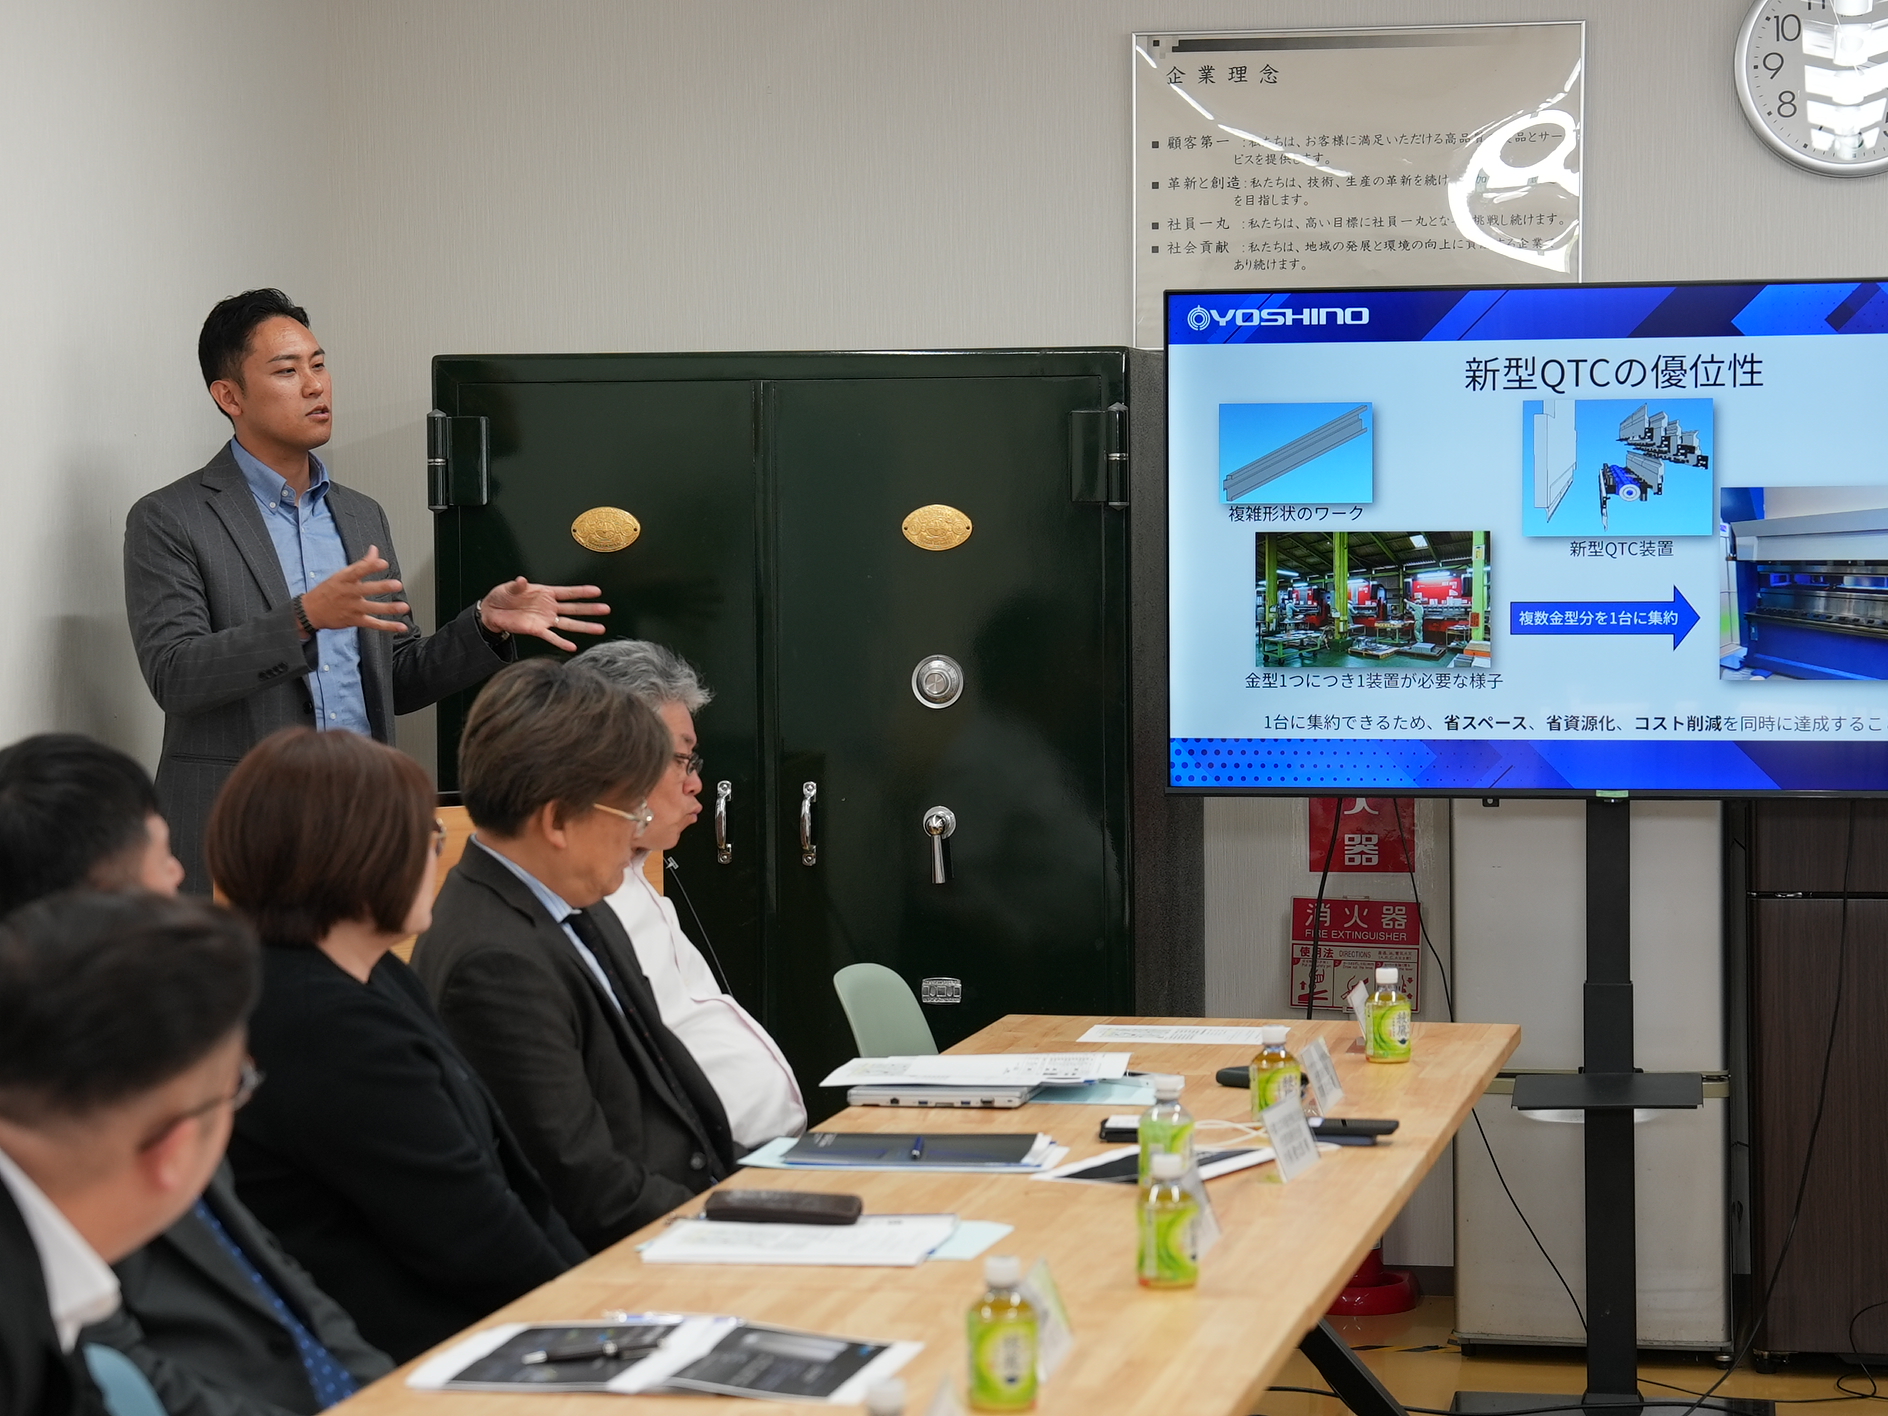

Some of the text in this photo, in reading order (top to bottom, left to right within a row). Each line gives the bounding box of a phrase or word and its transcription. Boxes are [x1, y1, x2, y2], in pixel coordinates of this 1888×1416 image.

[1774, 14, 1801, 42] 10
[1166, 64, 1279, 85] 企業理念
[1762, 52, 1784, 80] 9
[1777, 90, 1797, 118] 8
[1234, 194, 1309, 207] を目指します。
[1234, 258, 1307, 271] あり続けます。
[1209, 307, 1370, 327] YOSHINO
[1464, 353, 1764, 393] 新型QTCの優位性
[1228, 504, 1365, 522] 複雑形状のワーク
[1569, 539, 1674, 559] 新型QTC装置
[1519, 610, 1679, 626] 複数金型分を1台に集約
[1245, 671, 1504, 690] 金型1つにつき1装置が必要な様子
[1264, 713, 1888, 734] 1台に集約できるため、省スペース、省資源化、コスト削減を同時に達成するこ
[1305, 903, 1408, 929] 消火器
[1305, 929, 1407, 942] FIRE EXTINGUISHER
[1299, 946, 1334, 958] 使用法
